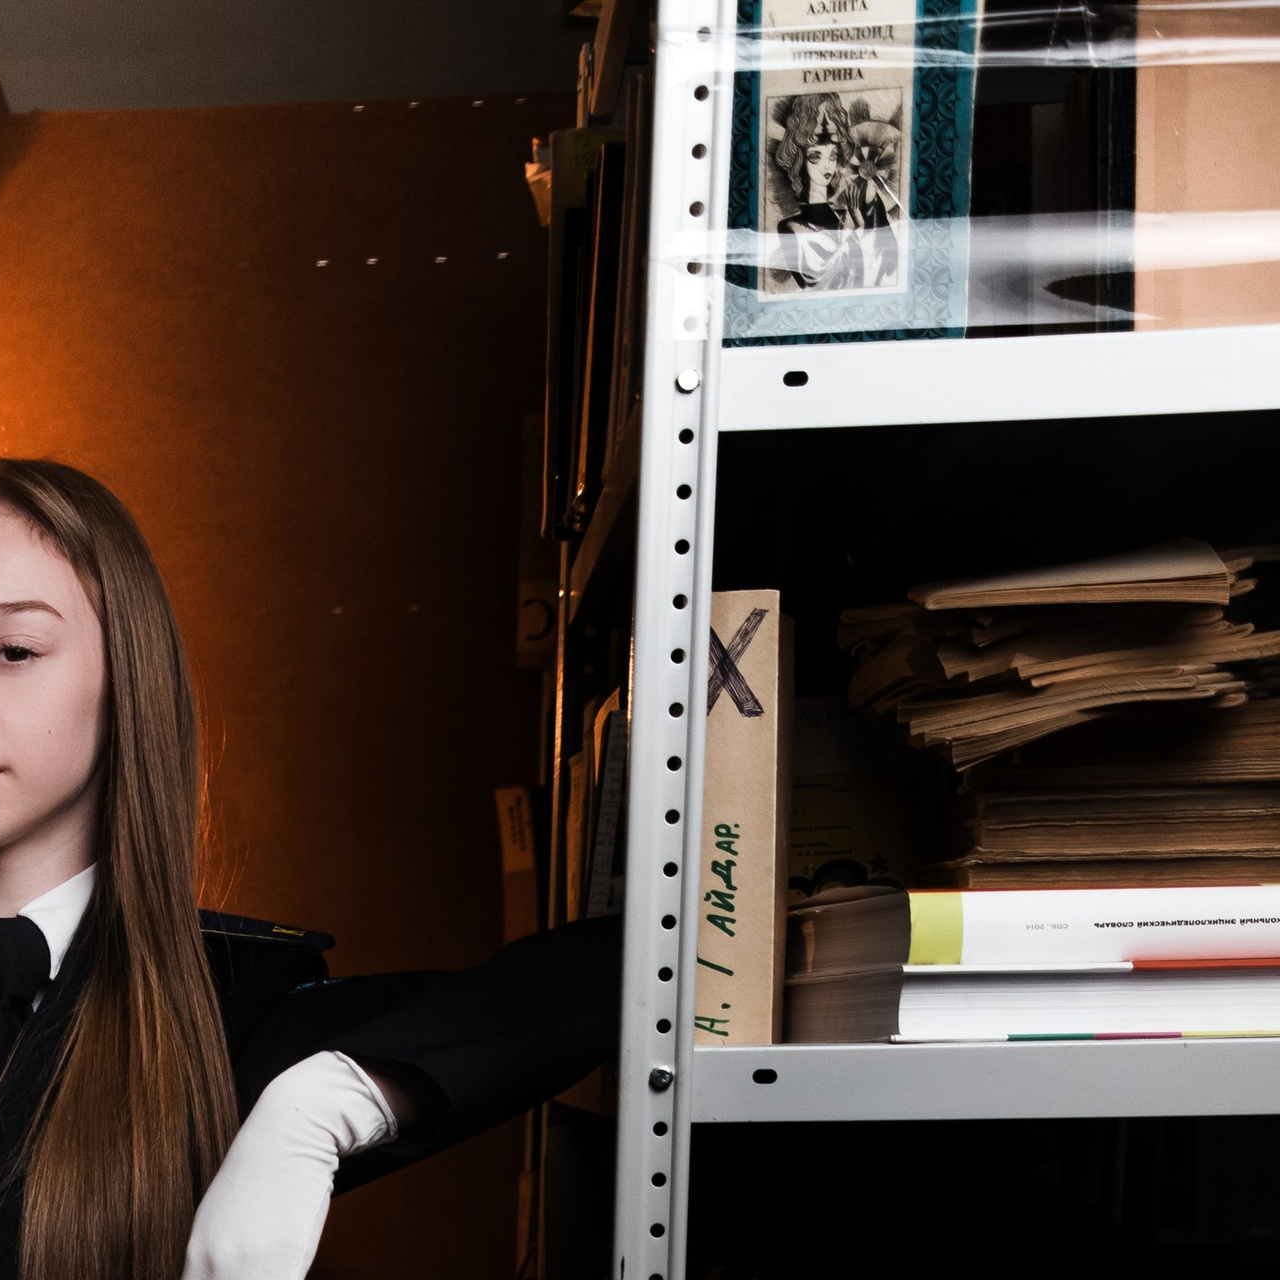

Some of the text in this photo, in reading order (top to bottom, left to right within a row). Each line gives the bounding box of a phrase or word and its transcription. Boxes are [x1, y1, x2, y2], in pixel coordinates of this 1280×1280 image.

[807, 0, 869, 15] АЭЛИТА
[781, 25, 894, 42] ГИПЕРБОЛОИД
[802, 67, 864, 83] ГАРИНА
[1025, 923, 1045, 931] 2014
[1094, 921, 1134, 929] СЛОВАРЬ
[1137, 918, 1237, 929] ЭНЦИКЛОПЕДИЧЕСКИЙ
[1239, 917, 1280, 926] КОЛЬНЫЙ
